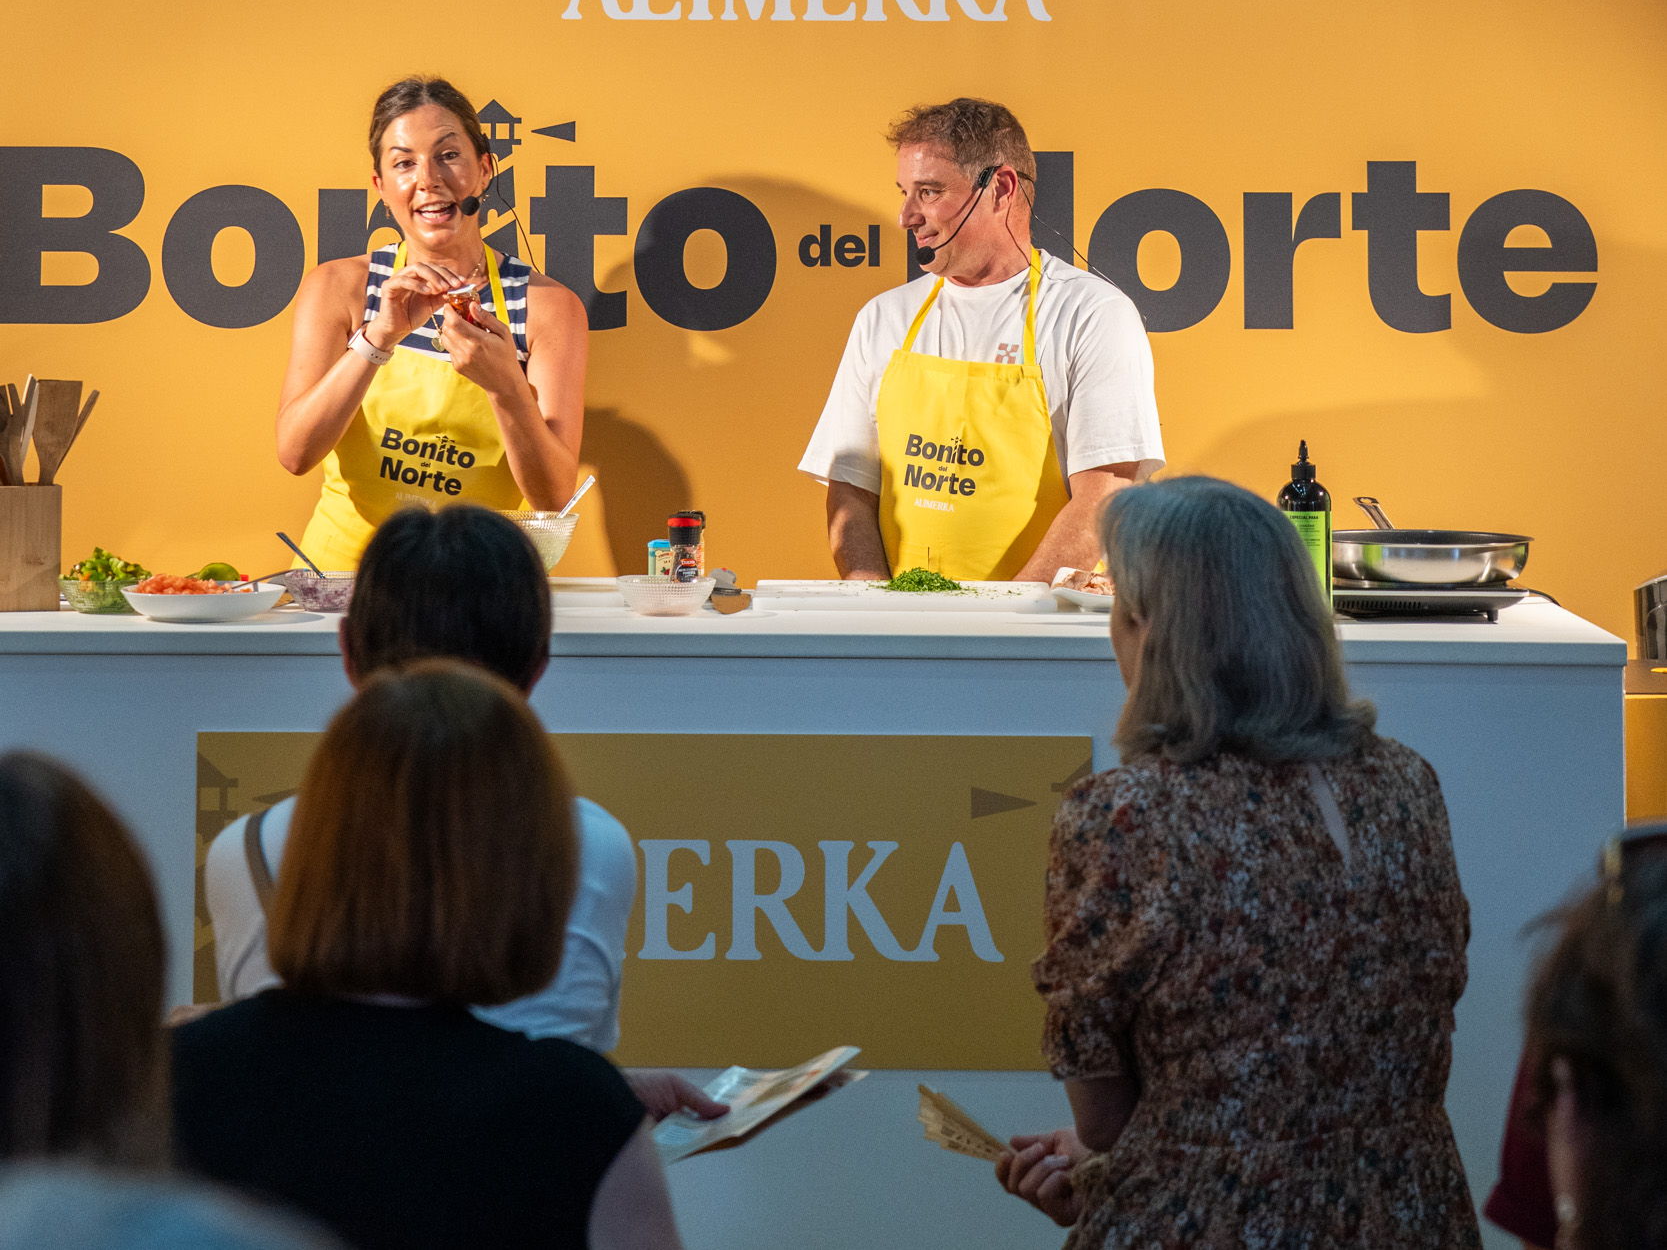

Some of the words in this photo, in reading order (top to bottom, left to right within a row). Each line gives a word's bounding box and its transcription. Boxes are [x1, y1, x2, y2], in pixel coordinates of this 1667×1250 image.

[798, 224, 881, 268] del
[380, 426, 476, 469] Bonito
[904, 433, 985, 467] Bonito
[379, 456, 462, 496] Norte
[903, 463, 976, 496] Norte
[914, 497, 954, 512] ALIMERKA
[624, 838, 1005, 963] ERKA
